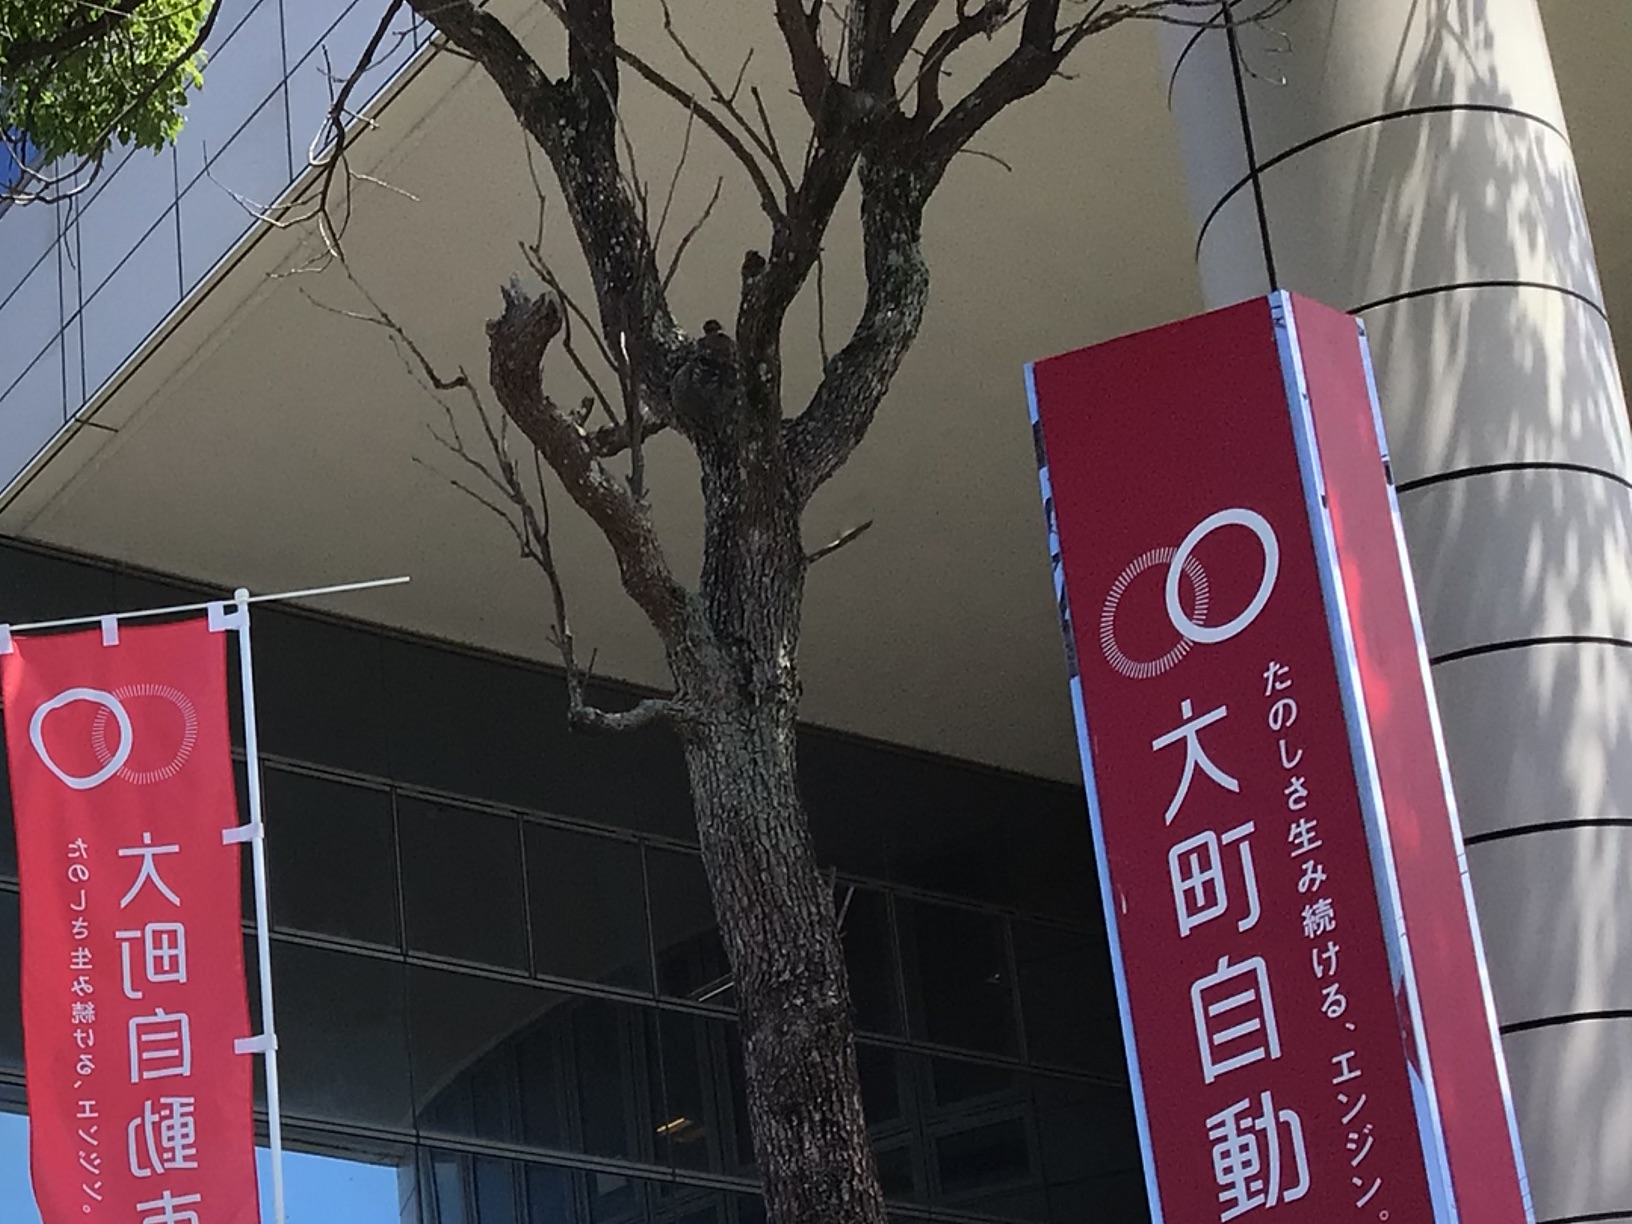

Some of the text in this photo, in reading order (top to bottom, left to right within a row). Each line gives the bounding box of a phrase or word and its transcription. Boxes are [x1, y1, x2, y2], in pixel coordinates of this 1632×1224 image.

[1263, 661, 1390, 1222] たのしさ生み続ける、エンジン。
